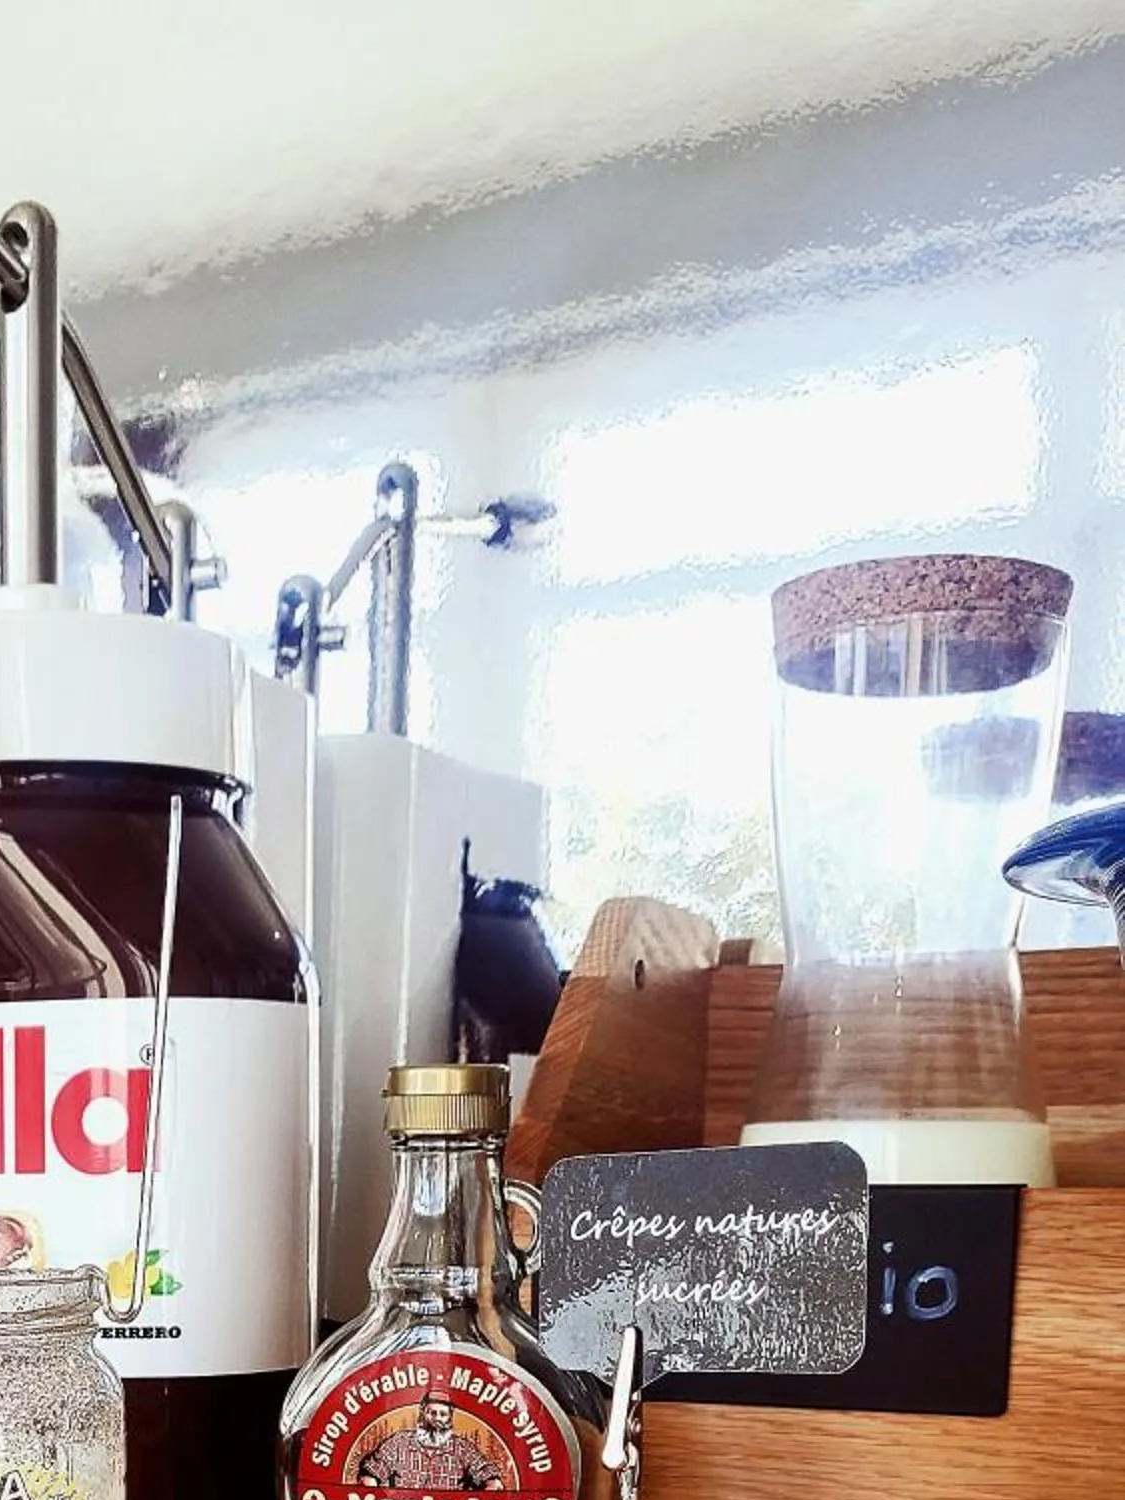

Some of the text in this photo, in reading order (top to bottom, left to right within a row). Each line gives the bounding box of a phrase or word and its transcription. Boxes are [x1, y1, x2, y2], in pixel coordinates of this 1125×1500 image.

[570, 1204, 840, 1248] Crêpes natures
[635, 1270, 766, 1306] sucrées
[100, 1326, 182, 1341] ERRERO
[312, 1411, 349, 1467] Sirop
[343, 1364, 429, 1416] d'érable
[450, 1367, 516, 1414] Maple
[511, 1411, 553, 1473] syrup
